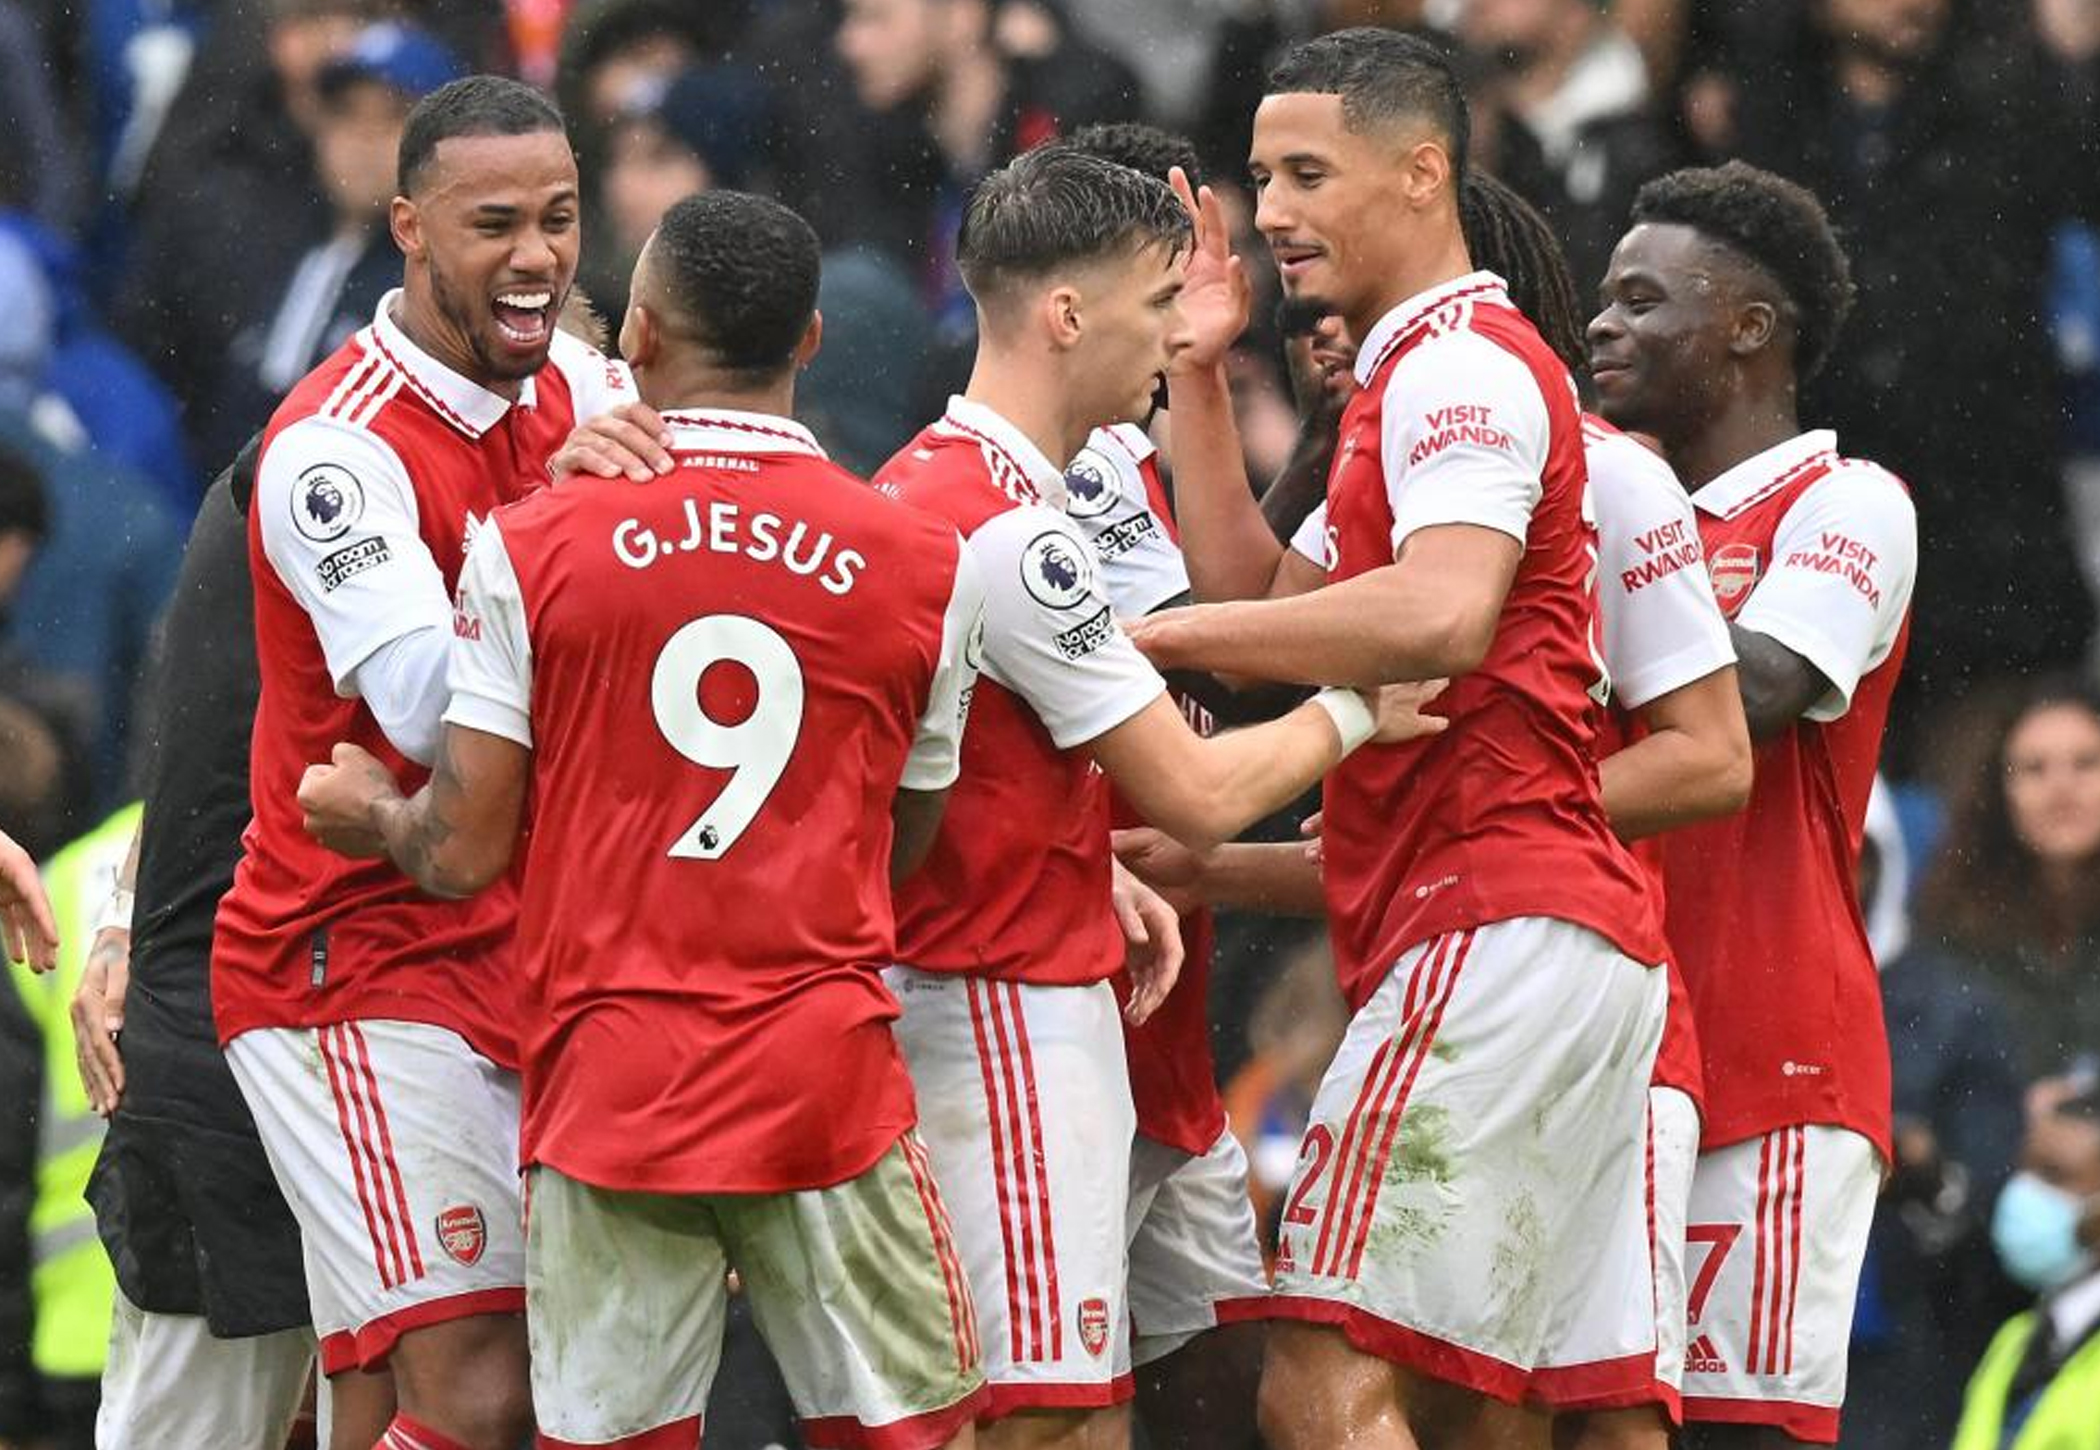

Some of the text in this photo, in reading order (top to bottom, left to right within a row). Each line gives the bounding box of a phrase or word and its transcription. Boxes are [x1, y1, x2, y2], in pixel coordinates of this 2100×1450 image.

[1425, 405, 1492, 430] VISIT
[682, 456, 759, 473] ARSENAL
[1409, 425, 1513, 467] RWANDA
[611, 497, 867, 597] G.JESUS
[1634, 519, 1685, 554] VISIT
[1821, 531, 1878, 571] VISIT
[1620, 539, 1699, 594] RWAND
[1784, 552, 1881, 612] RWANDA
[650, 613, 805, 861] 9
[1686, 1223, 1743, 1326] 7
[1684, 1357, 1728, 1373] didas
